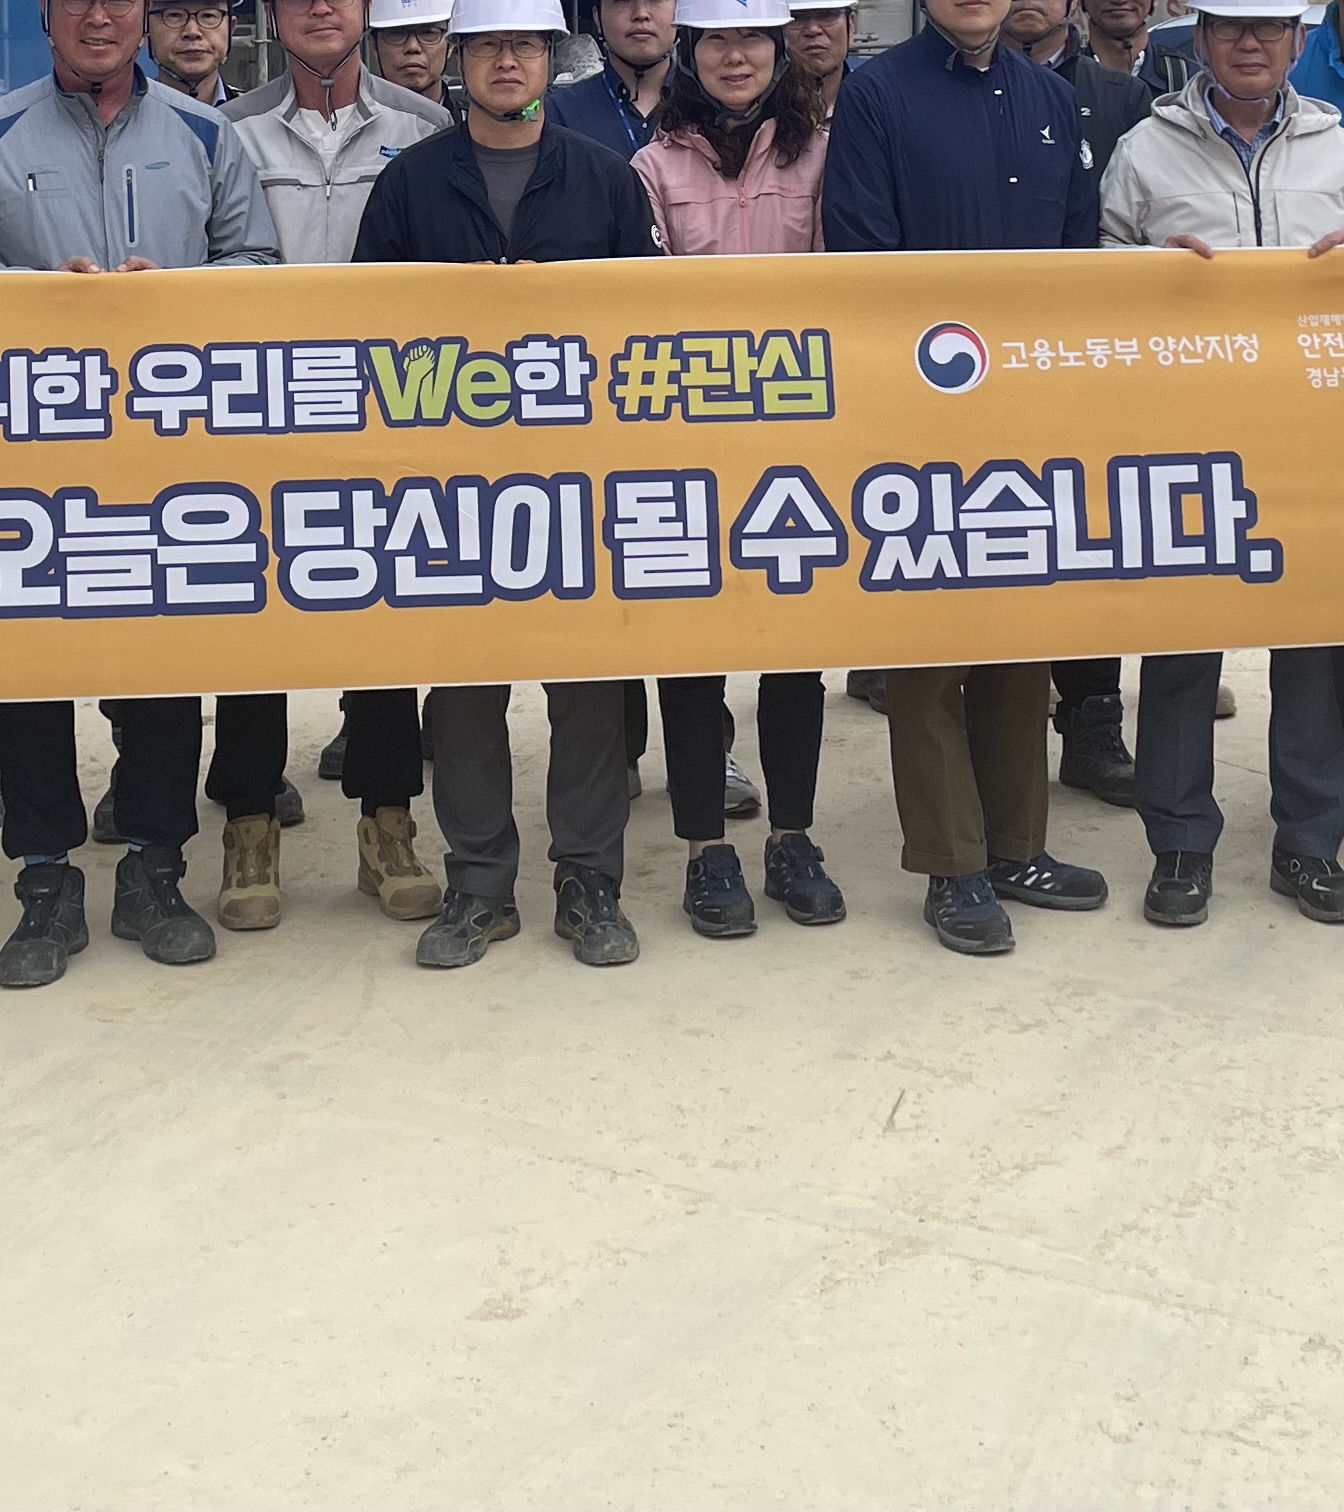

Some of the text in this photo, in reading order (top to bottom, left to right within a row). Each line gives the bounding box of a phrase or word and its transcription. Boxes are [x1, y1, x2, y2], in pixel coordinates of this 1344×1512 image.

[613, 333, 830, 419] #관심
[1001, 333, 1260, 370] 고용노동부 양산지청
[280, 481, 586, 602] 당신이
[612, 478, 713, 589] 될
[739, 475, 838, 584] 수
[860, 461, 1274, 583] 있습니다.
